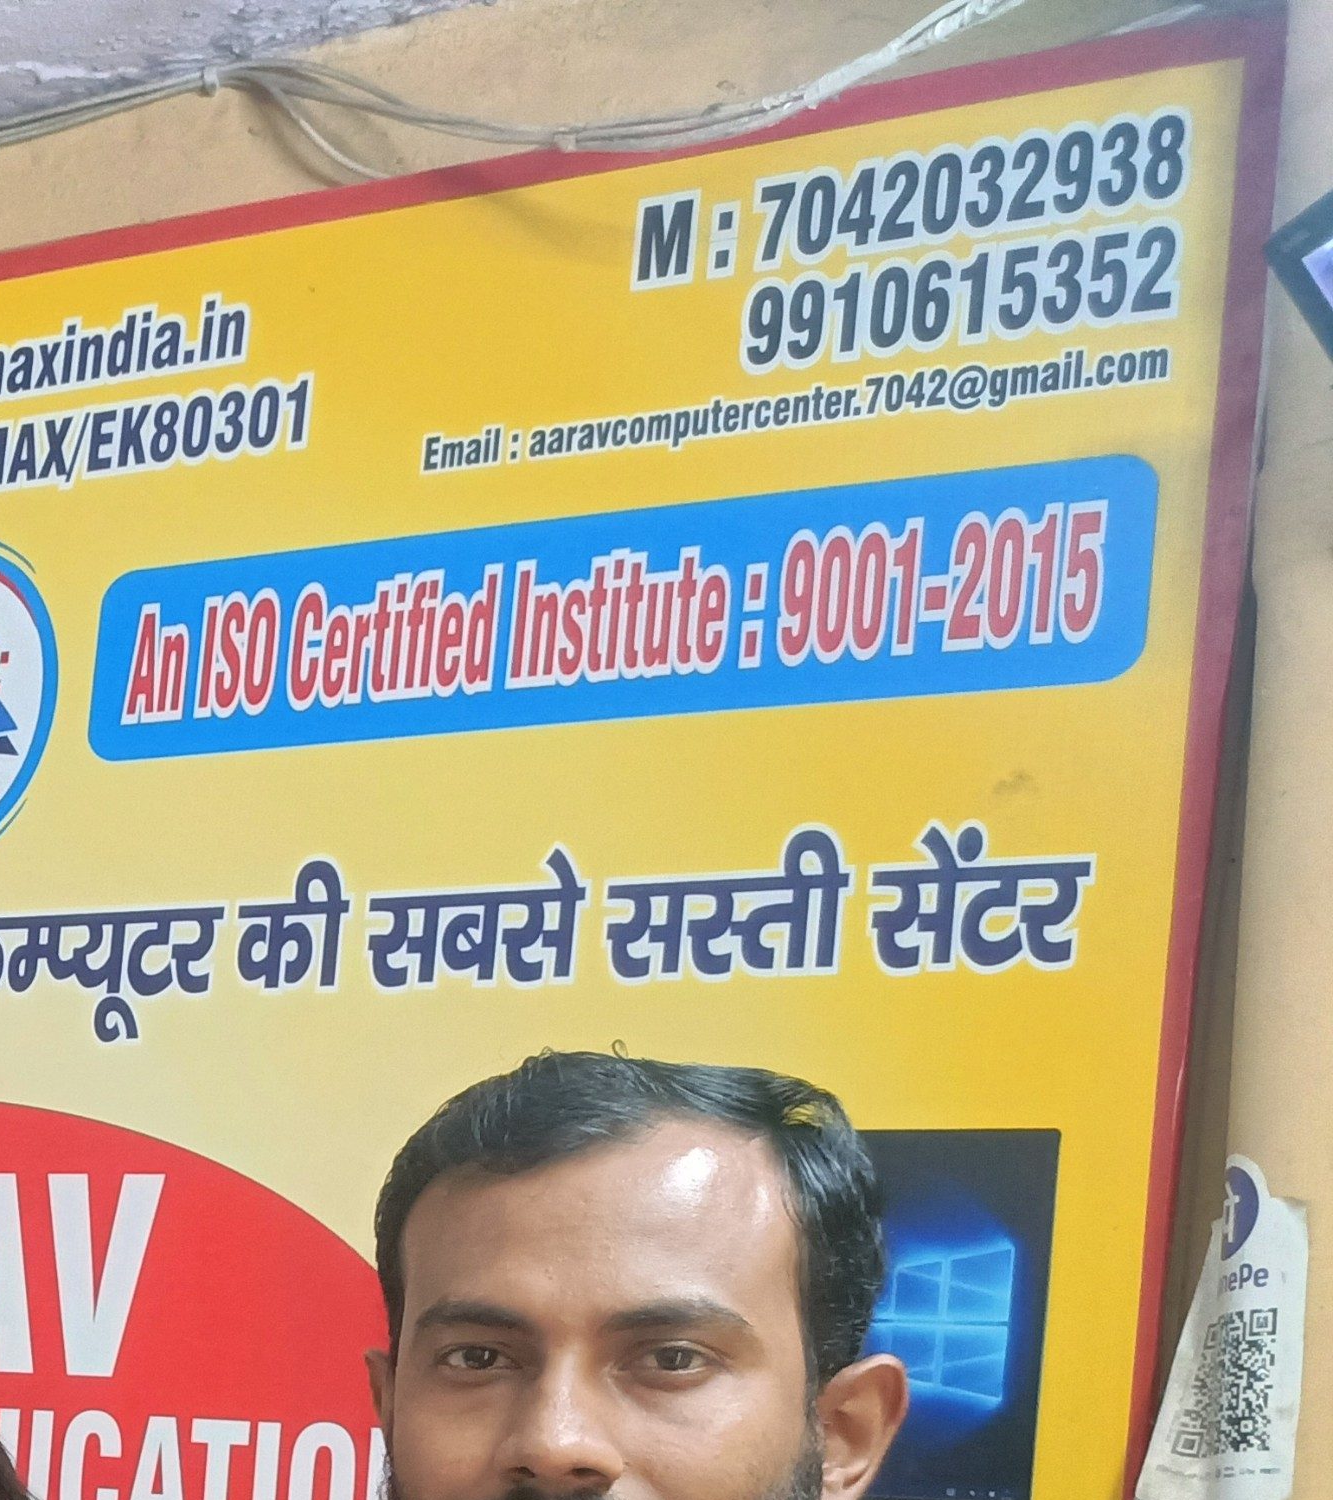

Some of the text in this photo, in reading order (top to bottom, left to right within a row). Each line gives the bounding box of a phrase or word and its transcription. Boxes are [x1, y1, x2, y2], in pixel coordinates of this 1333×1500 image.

[637, 200, 697, 284] M
[758, 115, 1186, 264] 7042032938
[744, 228, 1175, 367] 9910615352
[422, 430, 501, 472] Email
[528, 347, 1169, 459] aaravcomputercenter.7042@gmail.com
[126, 610, 186, 723] An
[197, 594, 277, 711] ISO
[291, 565, 501, 706] Certified
[509, 550, 724, 686] Institute
[780, 503, 1107, 662] 9001-2015
[235, 861, 349, 990] की
[365, 846, 587, 987] सबसे
[604, 828, 849, 977] सस्ती
[870, 820, 1095, 972] सेंटर
